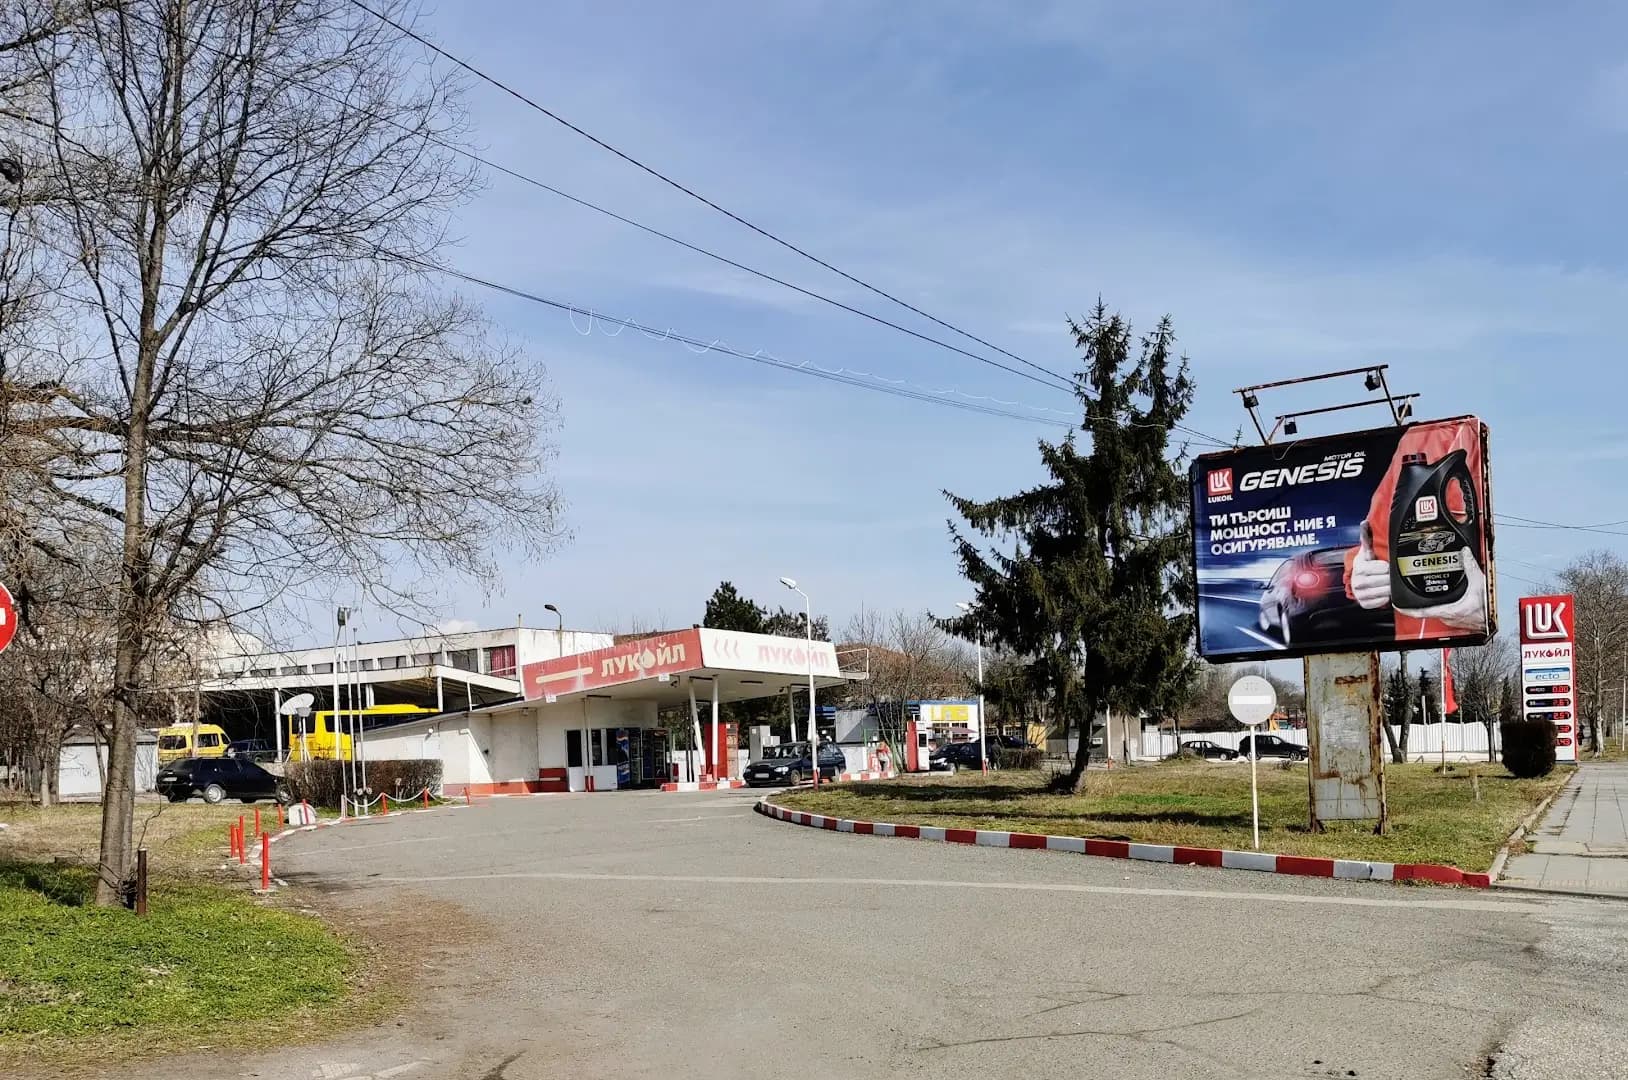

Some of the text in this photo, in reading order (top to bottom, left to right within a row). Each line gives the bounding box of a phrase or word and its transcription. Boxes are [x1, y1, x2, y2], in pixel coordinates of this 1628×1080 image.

[1210, 470, 1230, 492] LUK
[1240, 458, 1365, 491] GENESIS
[1208, 494, 1233, 503] LUKOIL
[1209, 506, 1291, 527] ТИ ТЪРСИШ
[1210, 515, 1336, 541] МОЩНОСТ. НИЕ Я
[1211, 533, 1320, 555] ОСИГУРЯВАМЕ.
[1413, 555, 1458, 567] GENESIS
[1526, 602, 1569, 640] LUK
[601, 643, 685, 677] ЛУКОЙЛ
[758, 644, 830, 667] ЛУКОЙЛ
[1524, 648, 1570, 659] ЛУКОЙЛ
